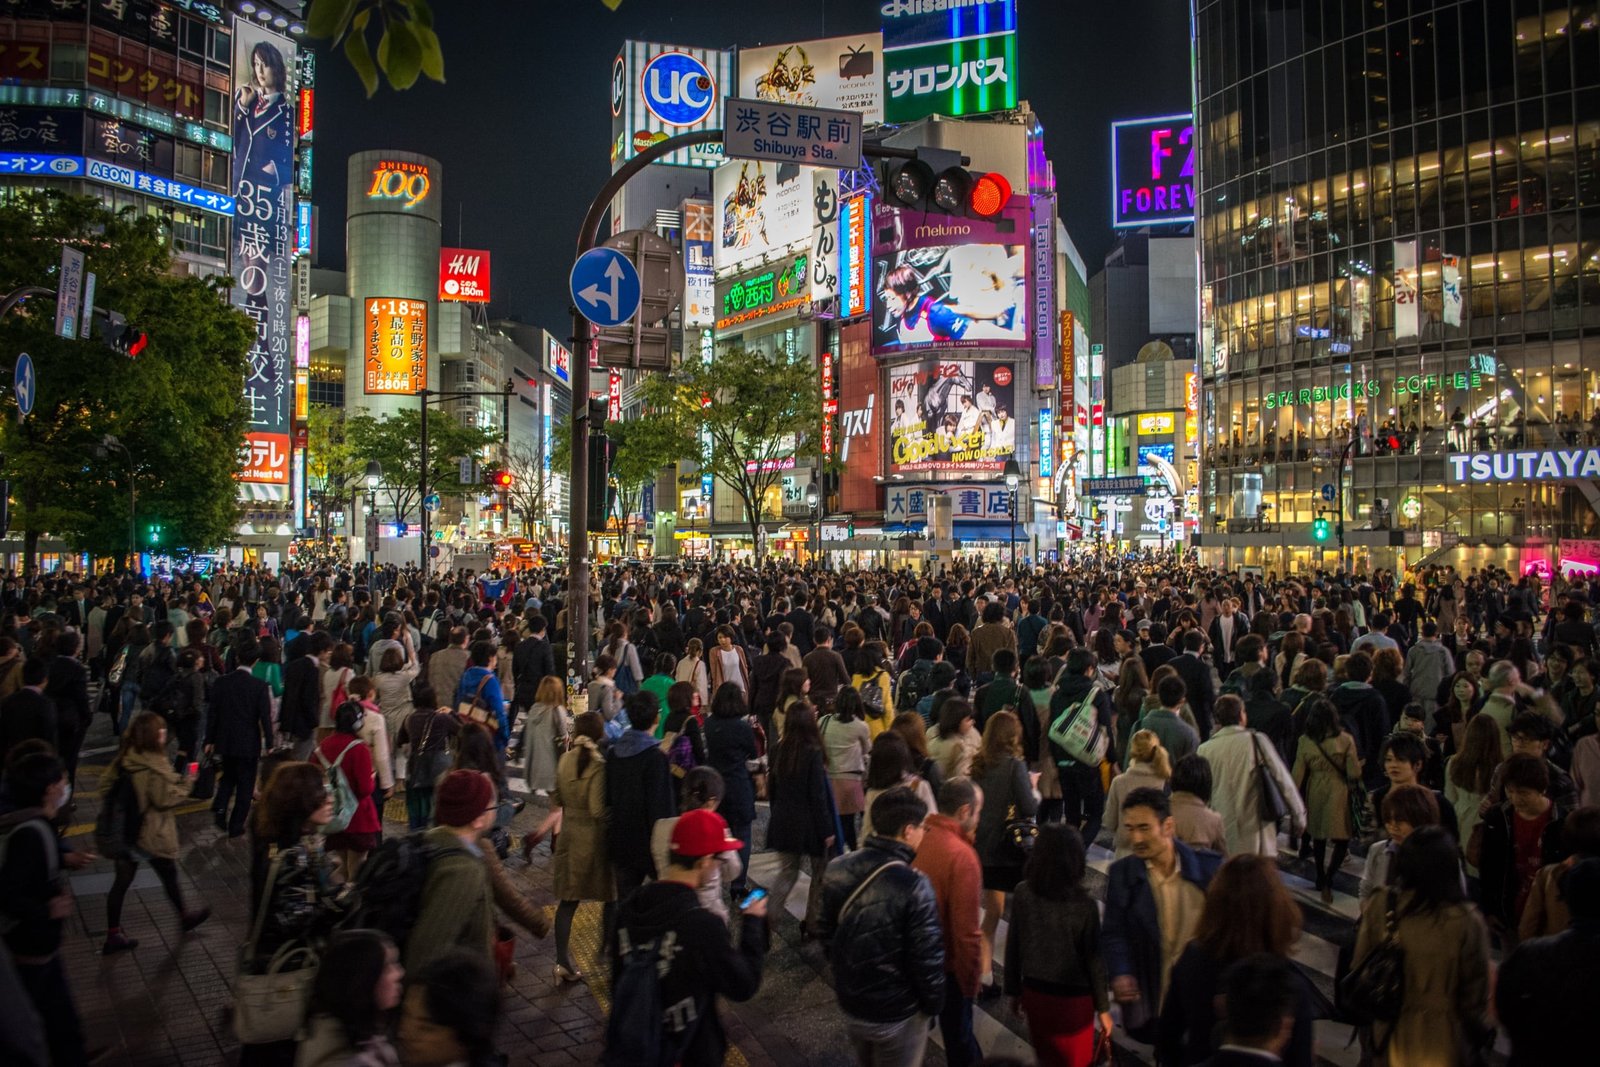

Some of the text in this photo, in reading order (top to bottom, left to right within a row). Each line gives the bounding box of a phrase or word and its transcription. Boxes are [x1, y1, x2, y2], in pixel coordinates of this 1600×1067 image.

[88, 52, 200, 108] コンタクト
[651, 68, 709, 108] UC
[887, 57, 1008, 98] サロンパス
[736, 107, 852, 144] 渋谷駅前
[694, 143, 723, 155] VISA
[754, 138, 838, 160] Shibuya Sta.
[56, 160, 73, 171] 6F
[90, 162, 132, 185] AEON
[380, 161, 429, 175] SHIBUYA
[137, 175, 232, 210] 英会話イーオン
[367, 169, 431, 208] 109
[814, 179, 838, 293] もんじゃ
[448, 253, 481, 277] H&M
[849, 201, 860, 308] 三千里薬品
[460, 286, 484, 297] 150m
[1037, 218, 1050, 338] Taisei neon
[746, 281, 774, 309] 西村
[389, 316, 405, 359] 最高の
[376, 379, 410, 391] 280円
[1266, 369, 1482, 409] STARBUCKS COFFEE
[951, 449, 974, 463] NOW
[1449, 449, 1600, 481] TSUTAYA
[890, 490, 1010, 514] 大盛書店
